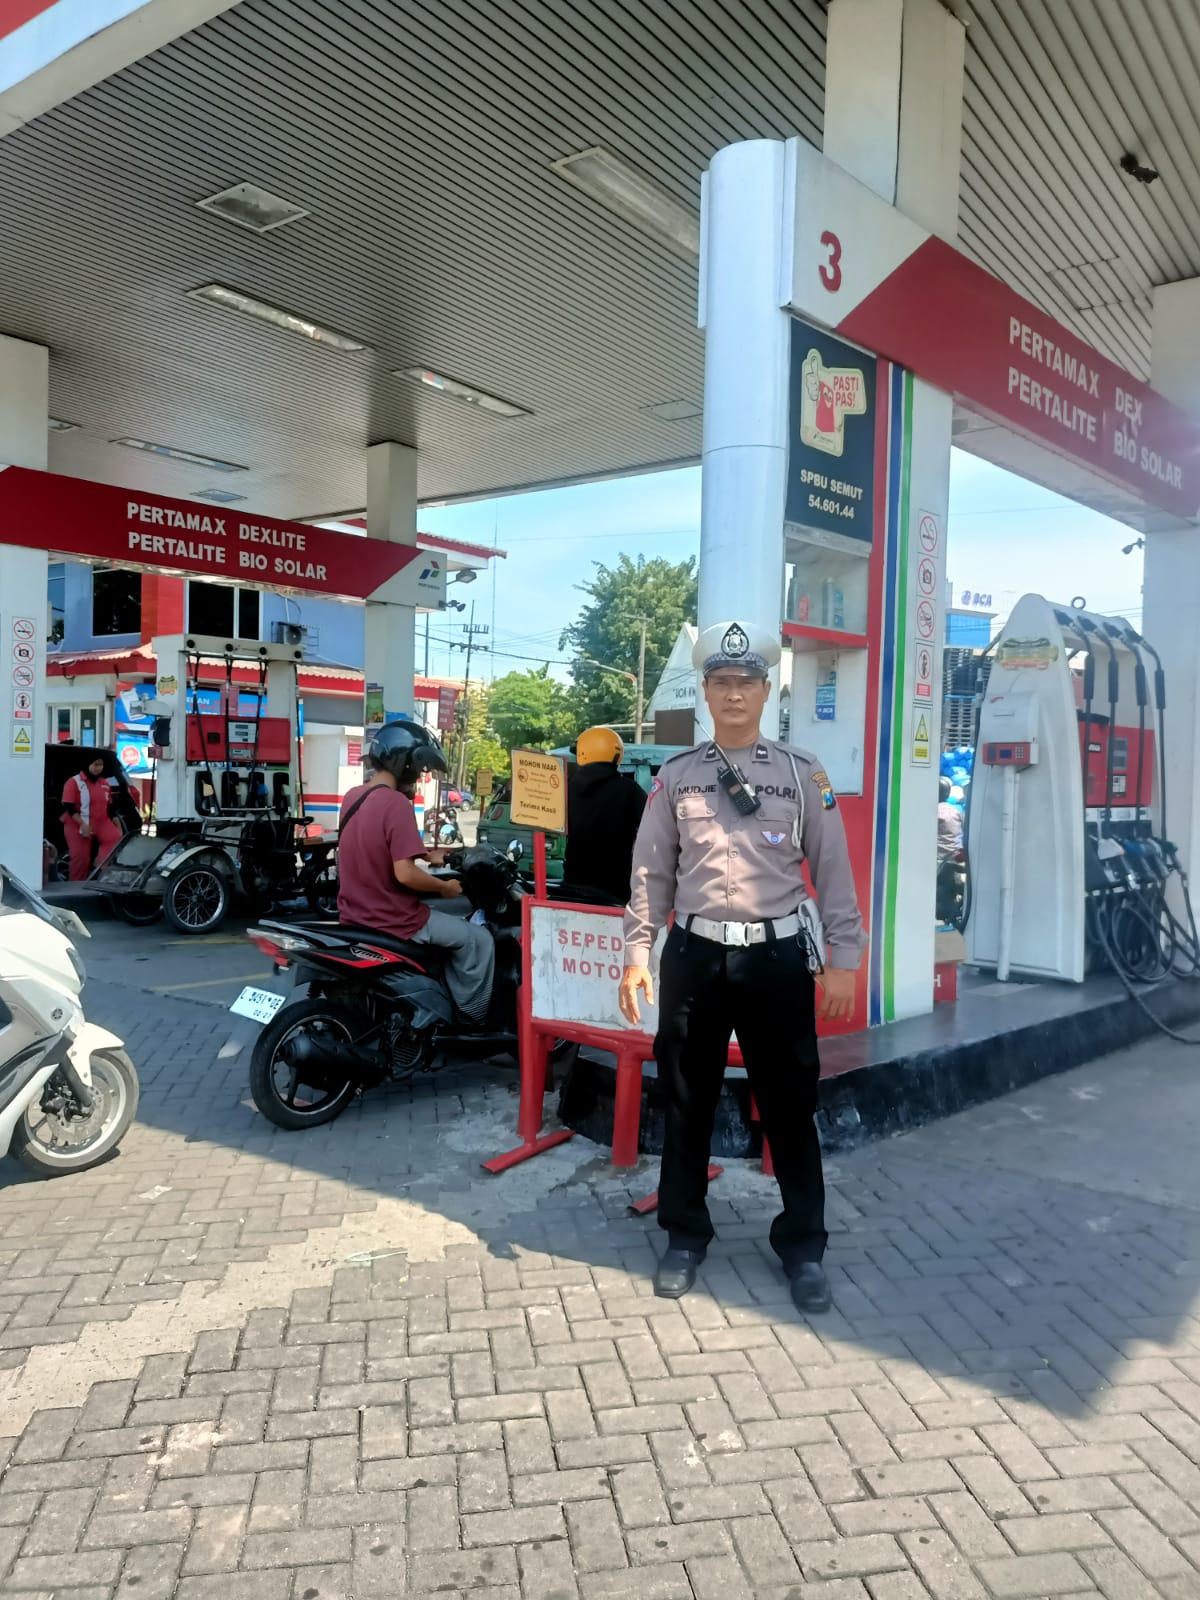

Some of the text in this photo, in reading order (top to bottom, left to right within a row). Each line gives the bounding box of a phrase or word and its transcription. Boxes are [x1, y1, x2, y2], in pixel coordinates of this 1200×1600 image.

[818, 230, 842, 293] 3
[1009, 316, 1100, 399] PERTAMAX
[833, 376, 859, 392] PASTI
[835, 391, 856, 408] PAS!
[1007, 366, 1183, 490] PERTALITE BIO SOLAR
[800, 469, 863, 501] SPBU SEMUT
[808, 494, 855, 520] 54.601.44
[127, 502, 306, 551] PERTAMAX DEXLITE
[128, 532, 328, 581] PERTALITE BIO SOLAR
[972, 593, 992, 607] BCA
[519, 759, 557, 771] MOHON MAAF
[677, 784, 718, 796] MUDJIE
[755, 784, 797, 800] POLRI
[519, 800, 540, 811] Terima
[558, 928, 623, 952] SEPED
[562, 957, 621, 980] MOTO
